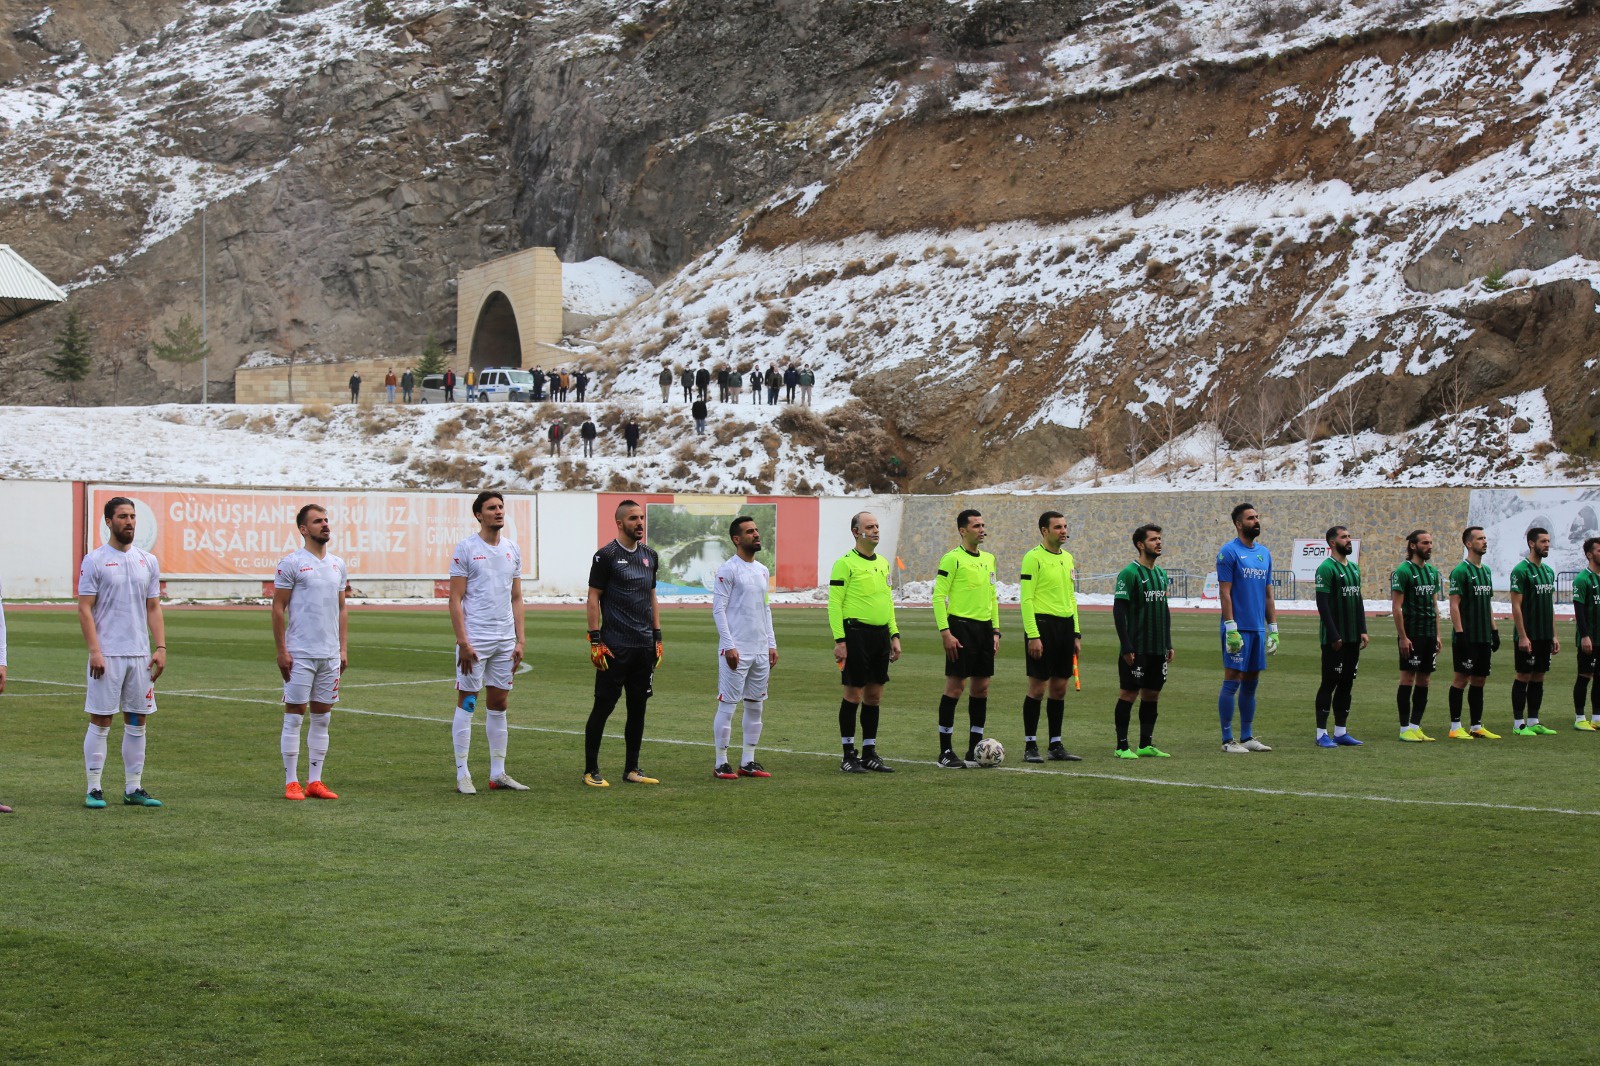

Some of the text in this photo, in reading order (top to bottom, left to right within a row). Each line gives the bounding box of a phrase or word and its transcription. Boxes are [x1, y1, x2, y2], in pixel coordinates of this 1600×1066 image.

[169, 497, 419, 528] GÜMÜŞHANE ORUMUZA
[183, 529, 305, 558] BAŞARILA
[146, 688, 154, 701] 4
[333, 679, 340, 691] 2
